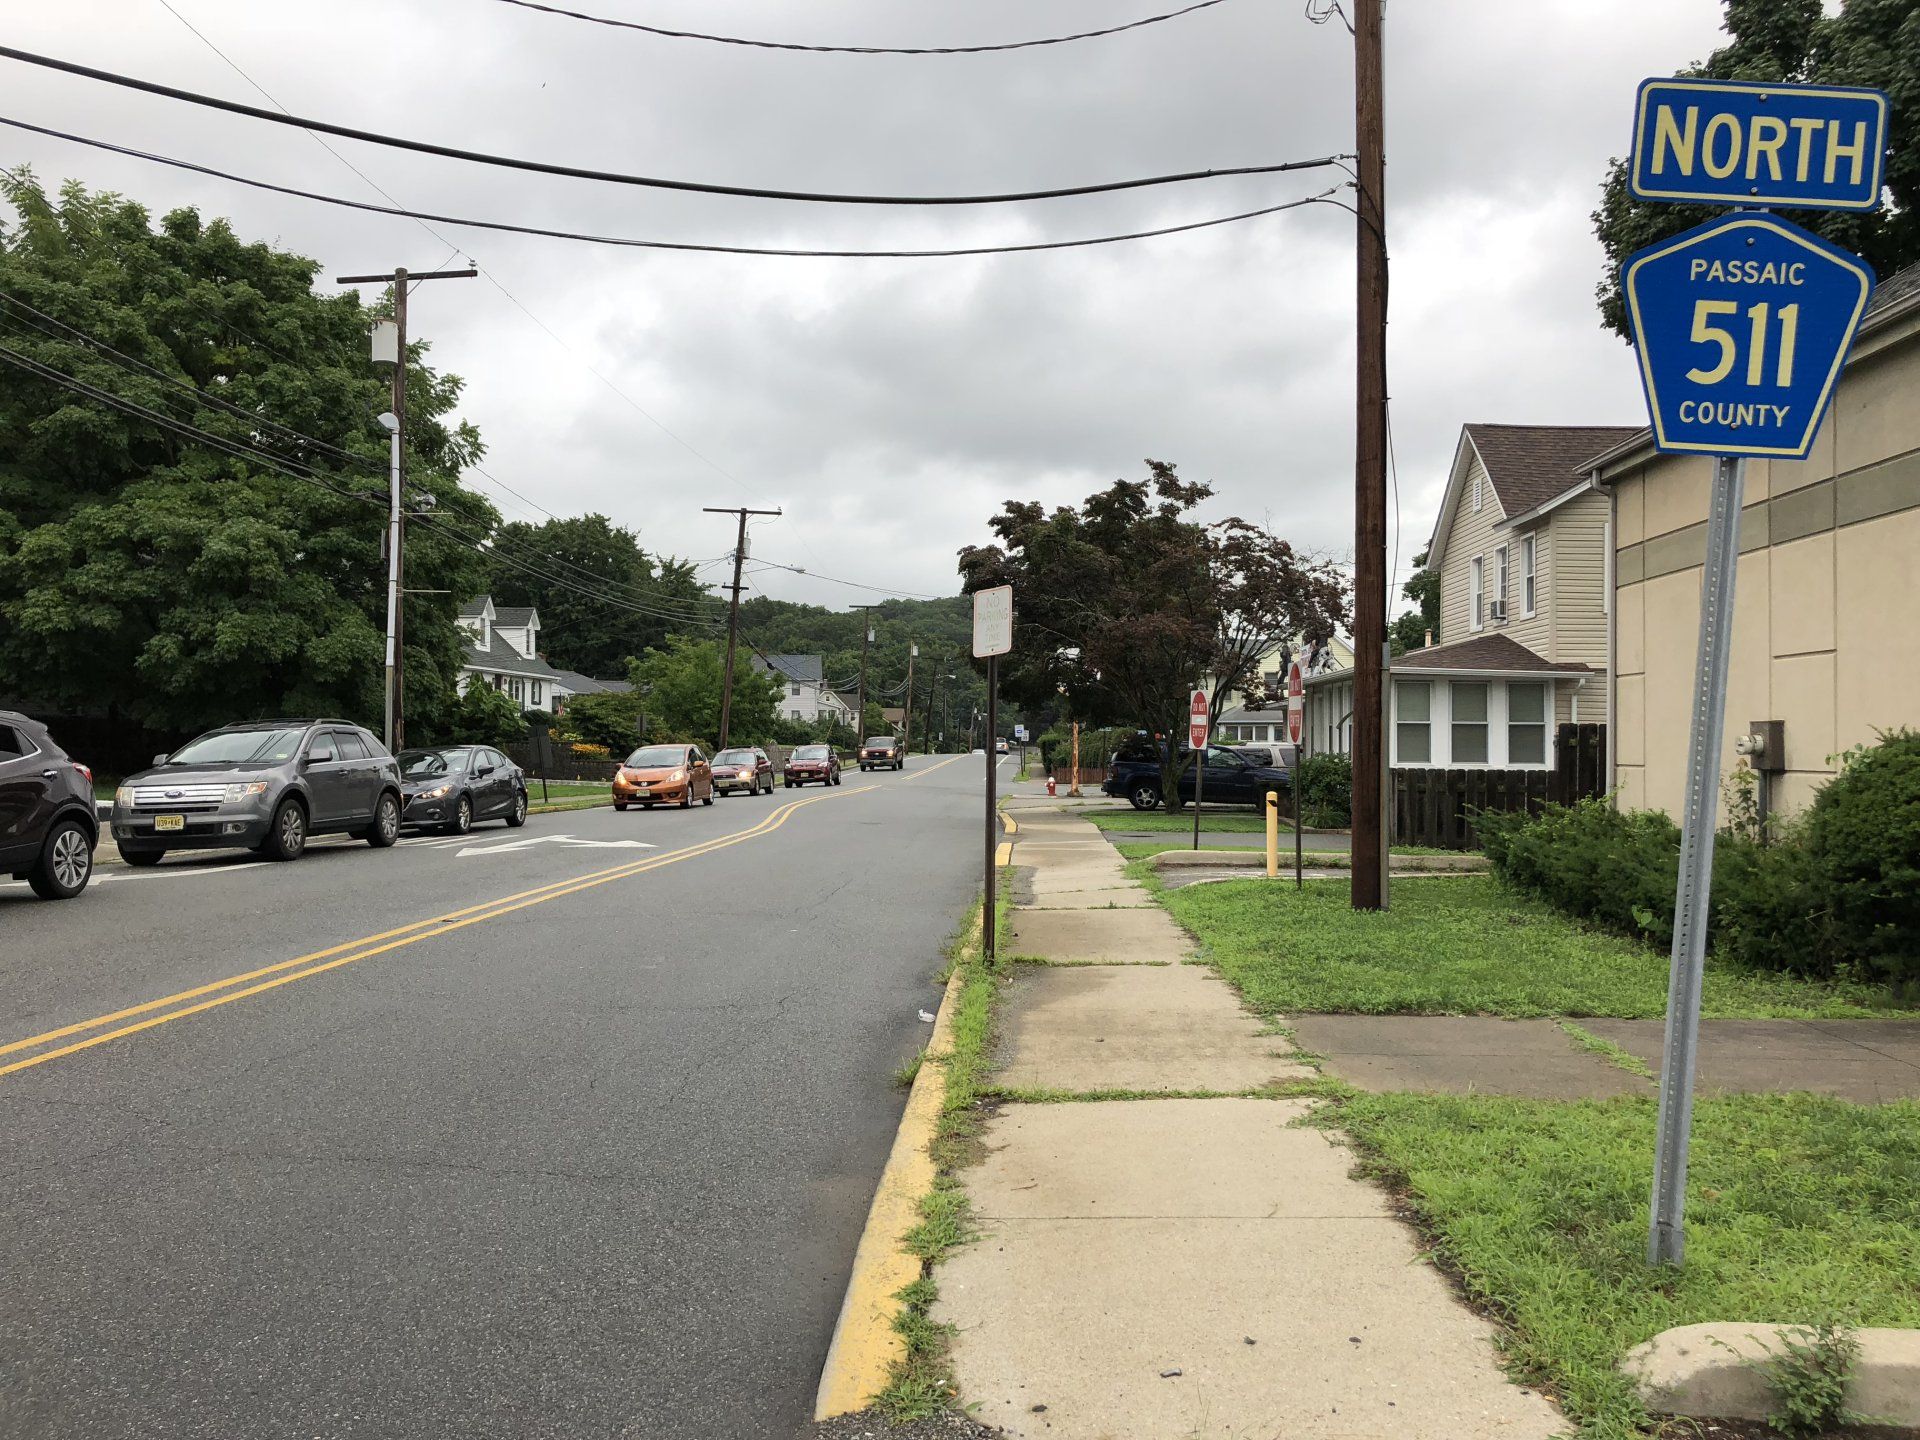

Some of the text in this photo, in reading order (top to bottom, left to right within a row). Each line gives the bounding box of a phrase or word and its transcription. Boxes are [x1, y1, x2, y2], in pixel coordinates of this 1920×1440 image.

[1650, 104, 1867, 186] NORTH
[1689, 258, 1806, 286] PASSAIC
[1684, 299, 1800, 388] 511
[1679, 400, 1791, 428] COUNTY
[1192, 702, 1199, 712] DO
[1192, 727, 1205, 738] ENTER
